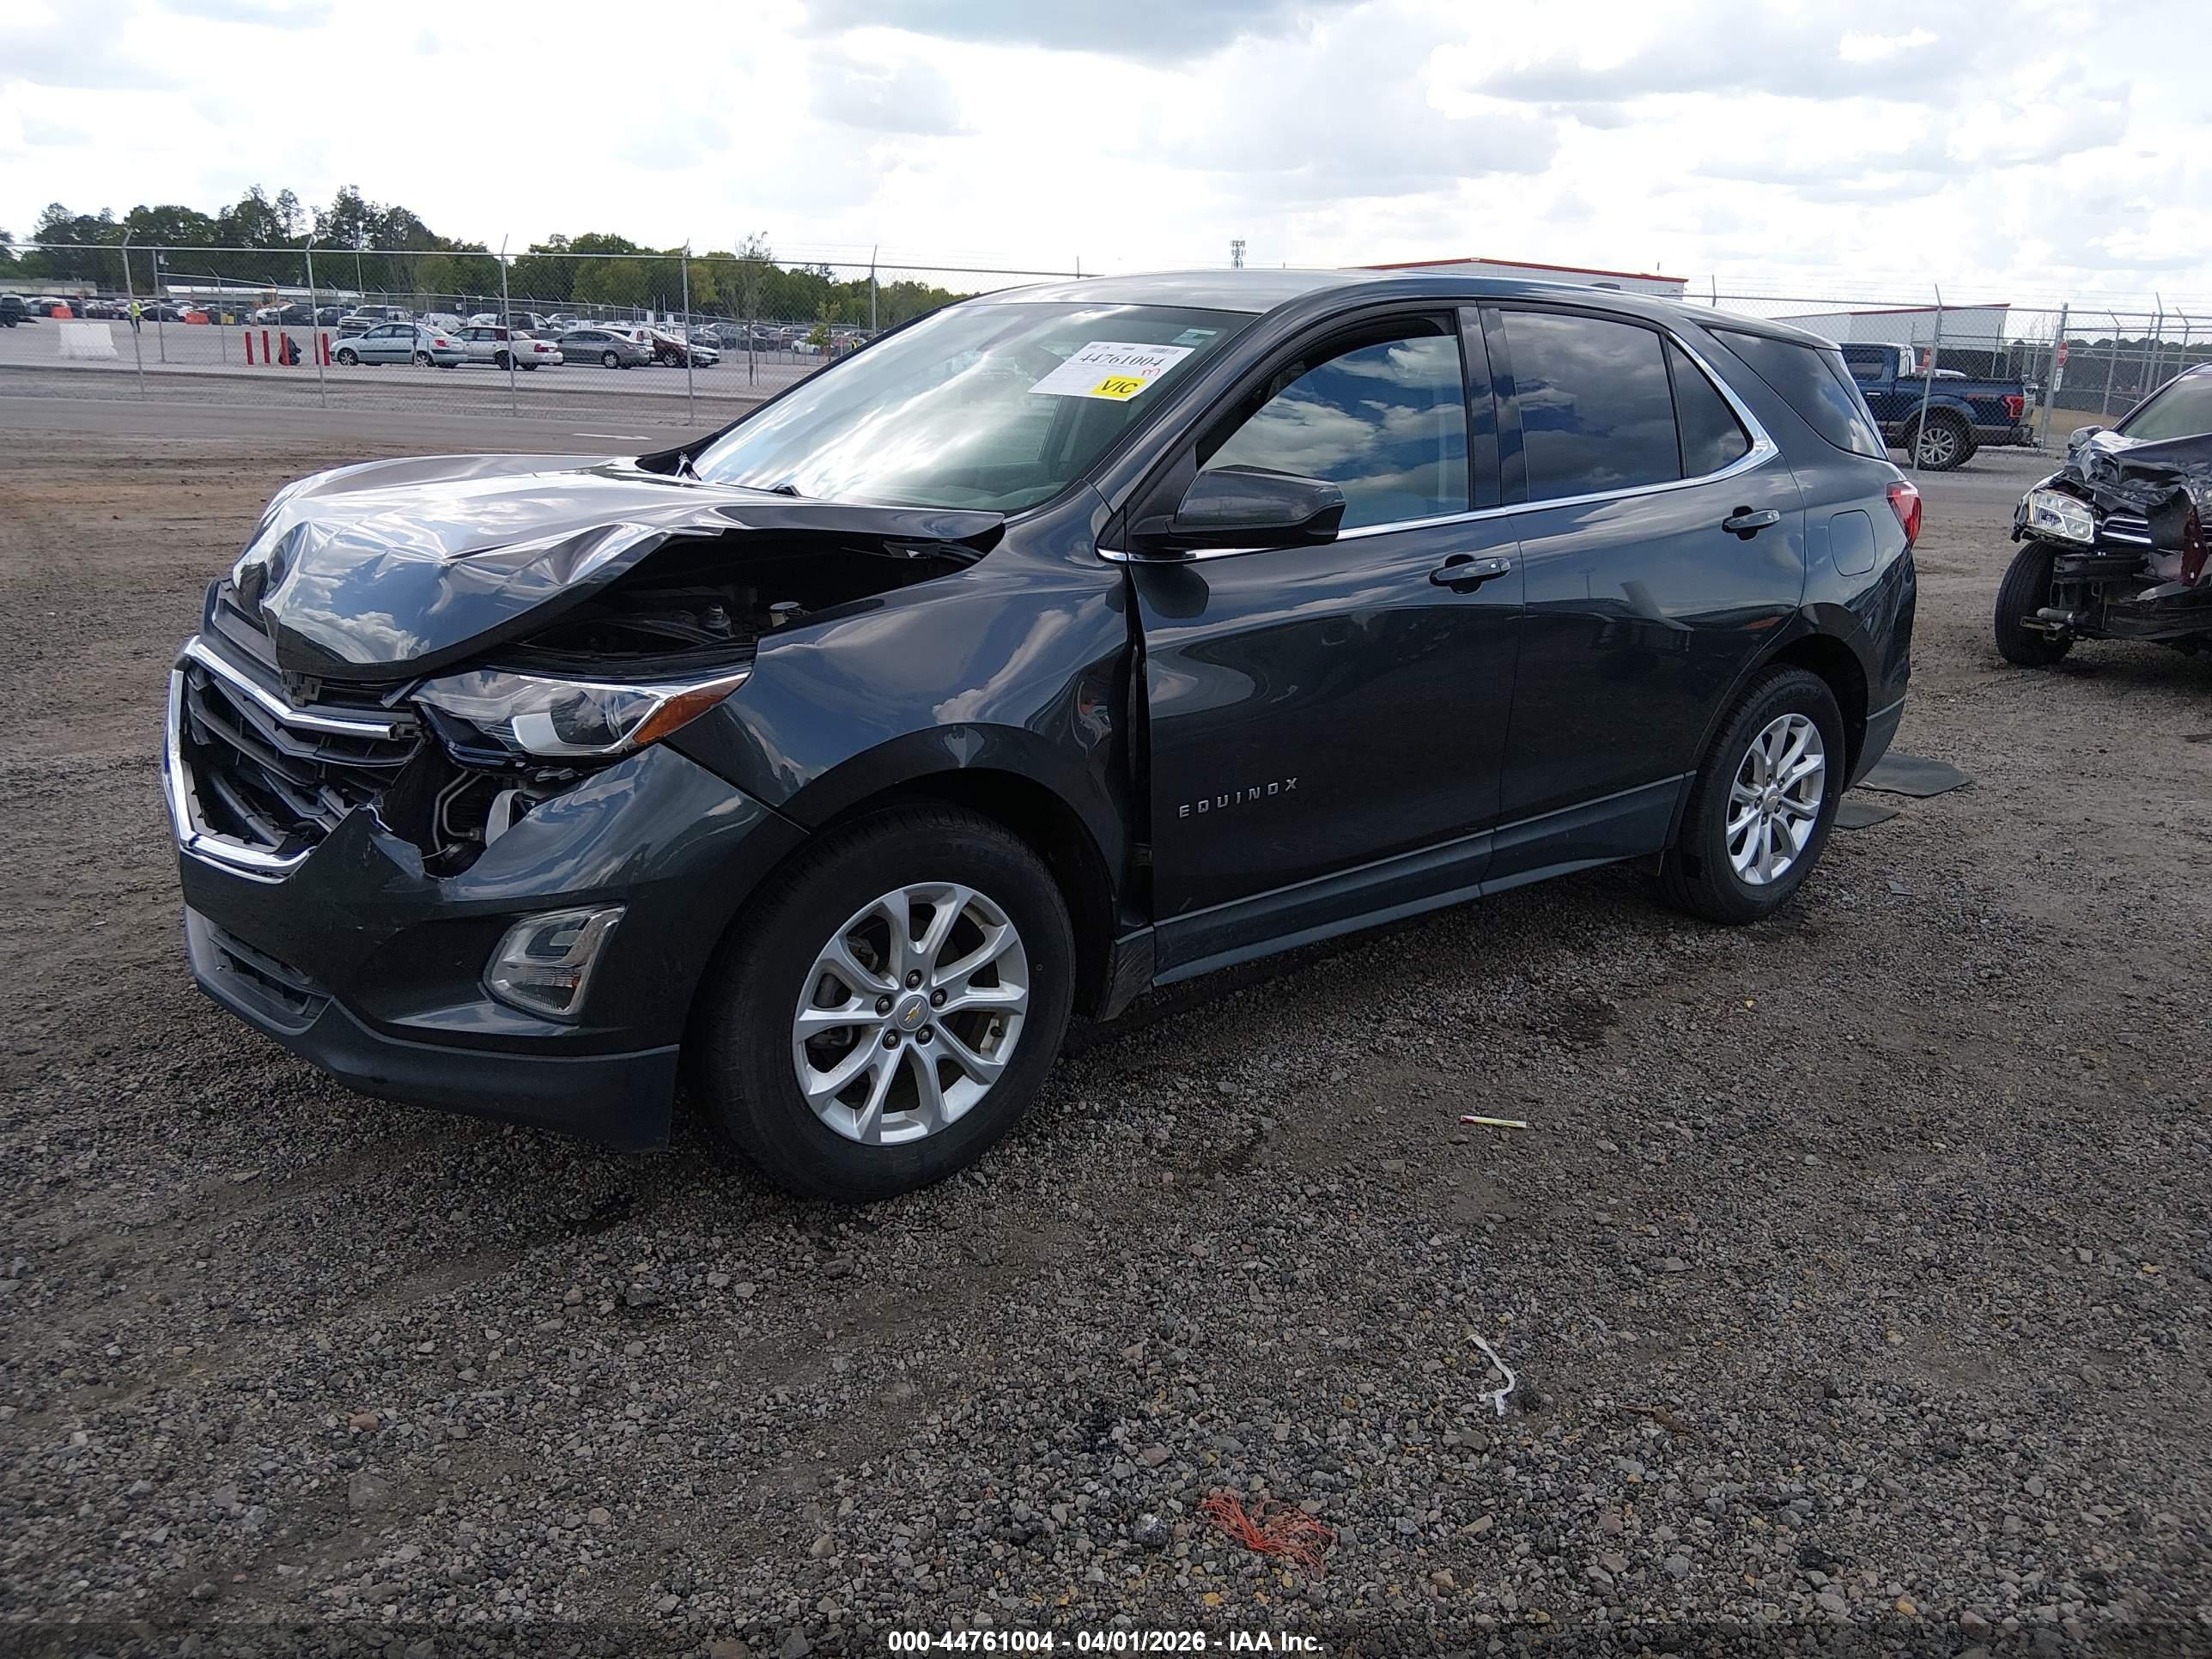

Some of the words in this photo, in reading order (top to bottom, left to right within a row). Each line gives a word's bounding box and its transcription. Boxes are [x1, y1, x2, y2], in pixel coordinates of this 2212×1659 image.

[1079, 352, 1166, 367] 44761004
[1101, 380, 1138, 394] VIC
[1178, 777, 1298, 818] EQUINOX
